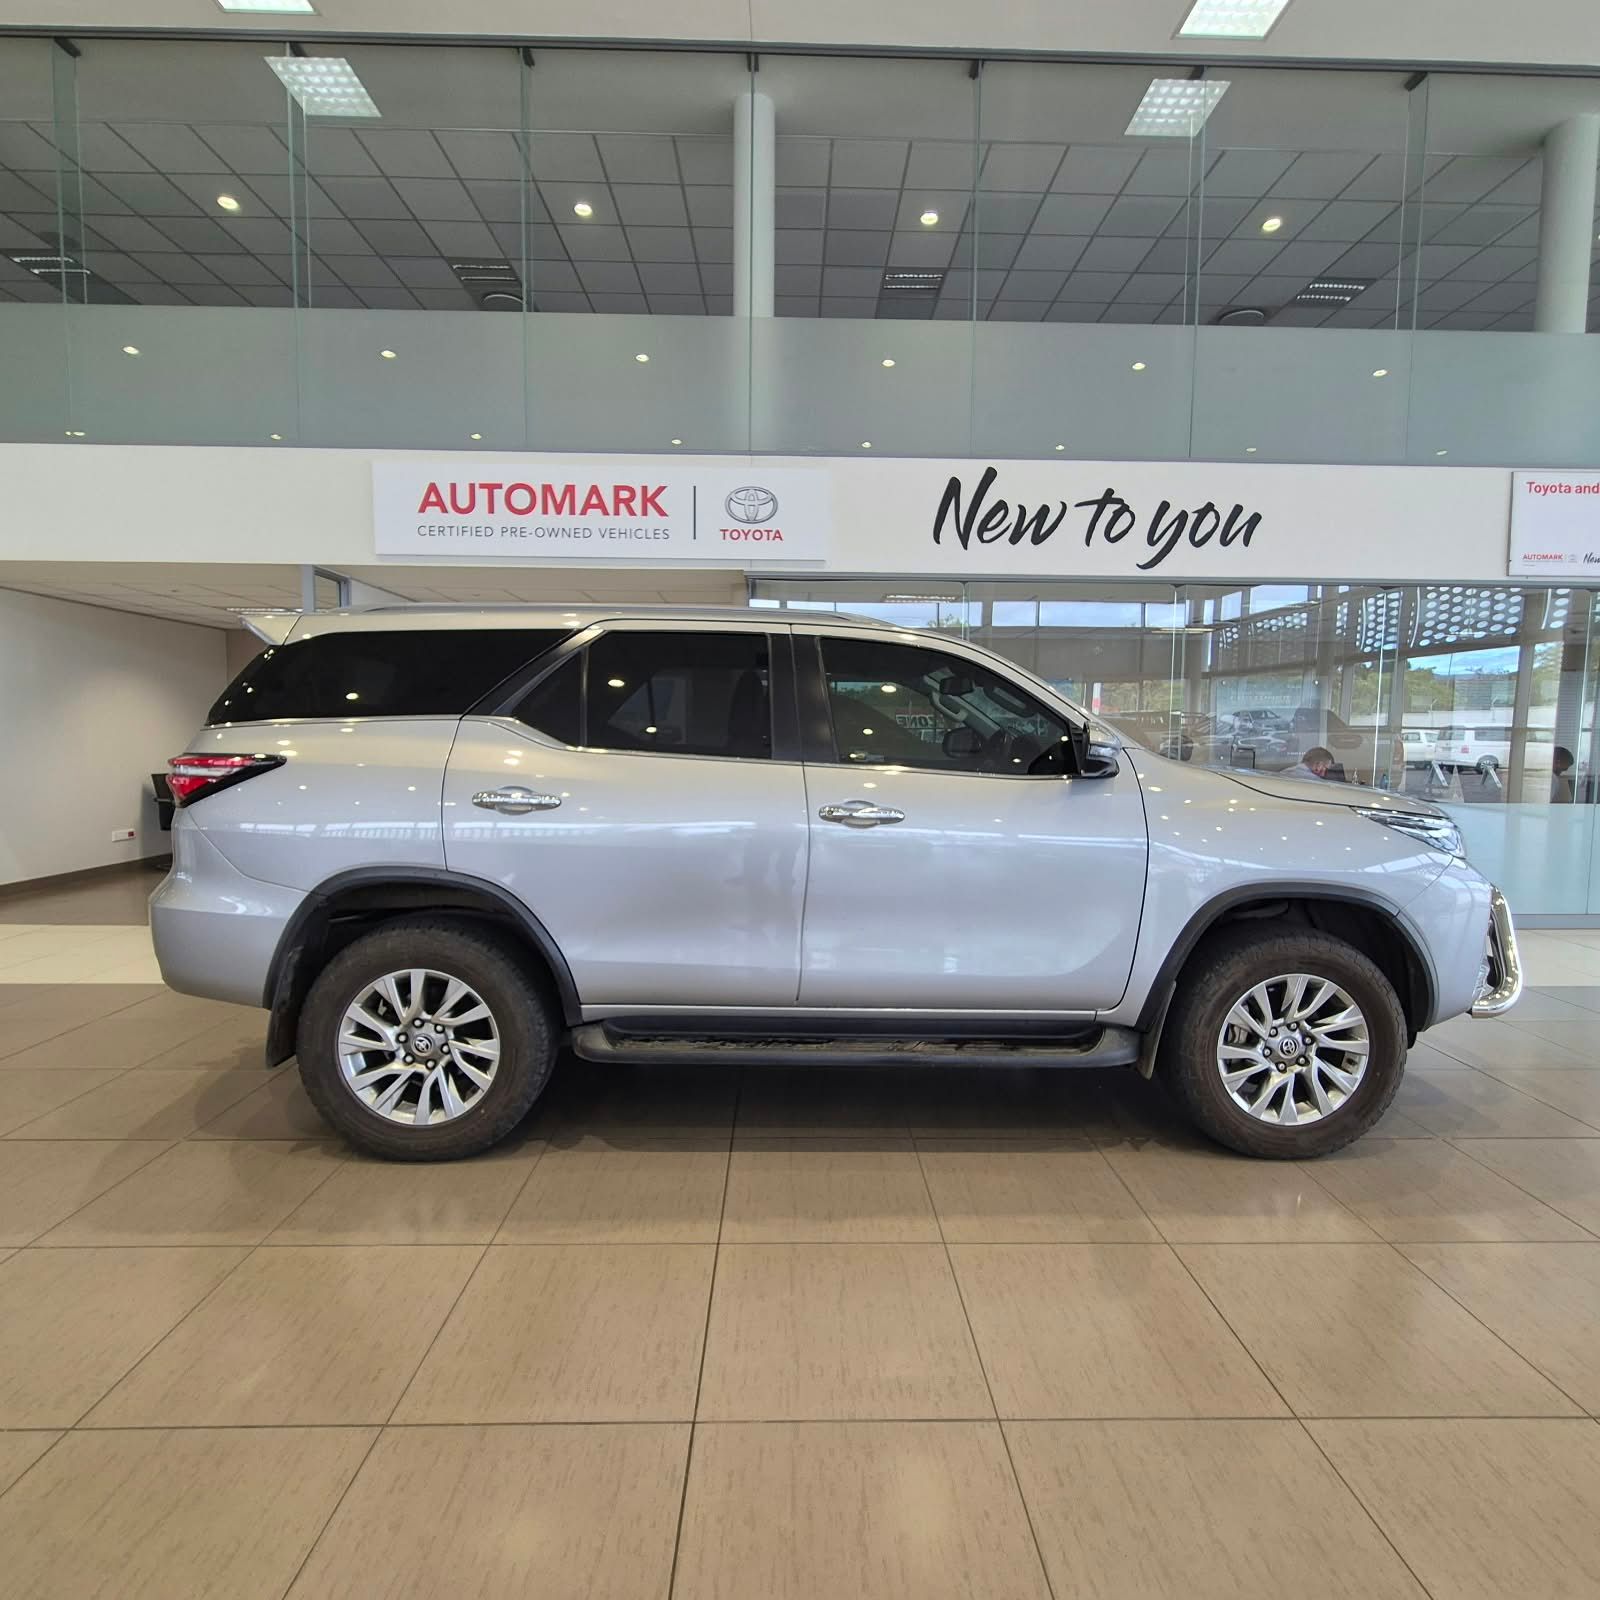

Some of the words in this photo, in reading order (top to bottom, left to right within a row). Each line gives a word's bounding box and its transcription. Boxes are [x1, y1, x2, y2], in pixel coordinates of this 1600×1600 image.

[1526, 481, 1572, 497] Toyota
[1574, 482, 1600, 495] and
[418, 481, 669, 518] AUTOMARK
[932, 466, 1068, 551] New
[1135, 500, 1263, 571] you
[417, 525, 494, 538] CERTIFIED
[501, 526, 593, 539] PRE-OWNED
[598, 527, 670, 540] VEHICLES
[719, 528, 784, 542] TOYOTA
[1522, 553, 1563, 561] AUTOMARK
